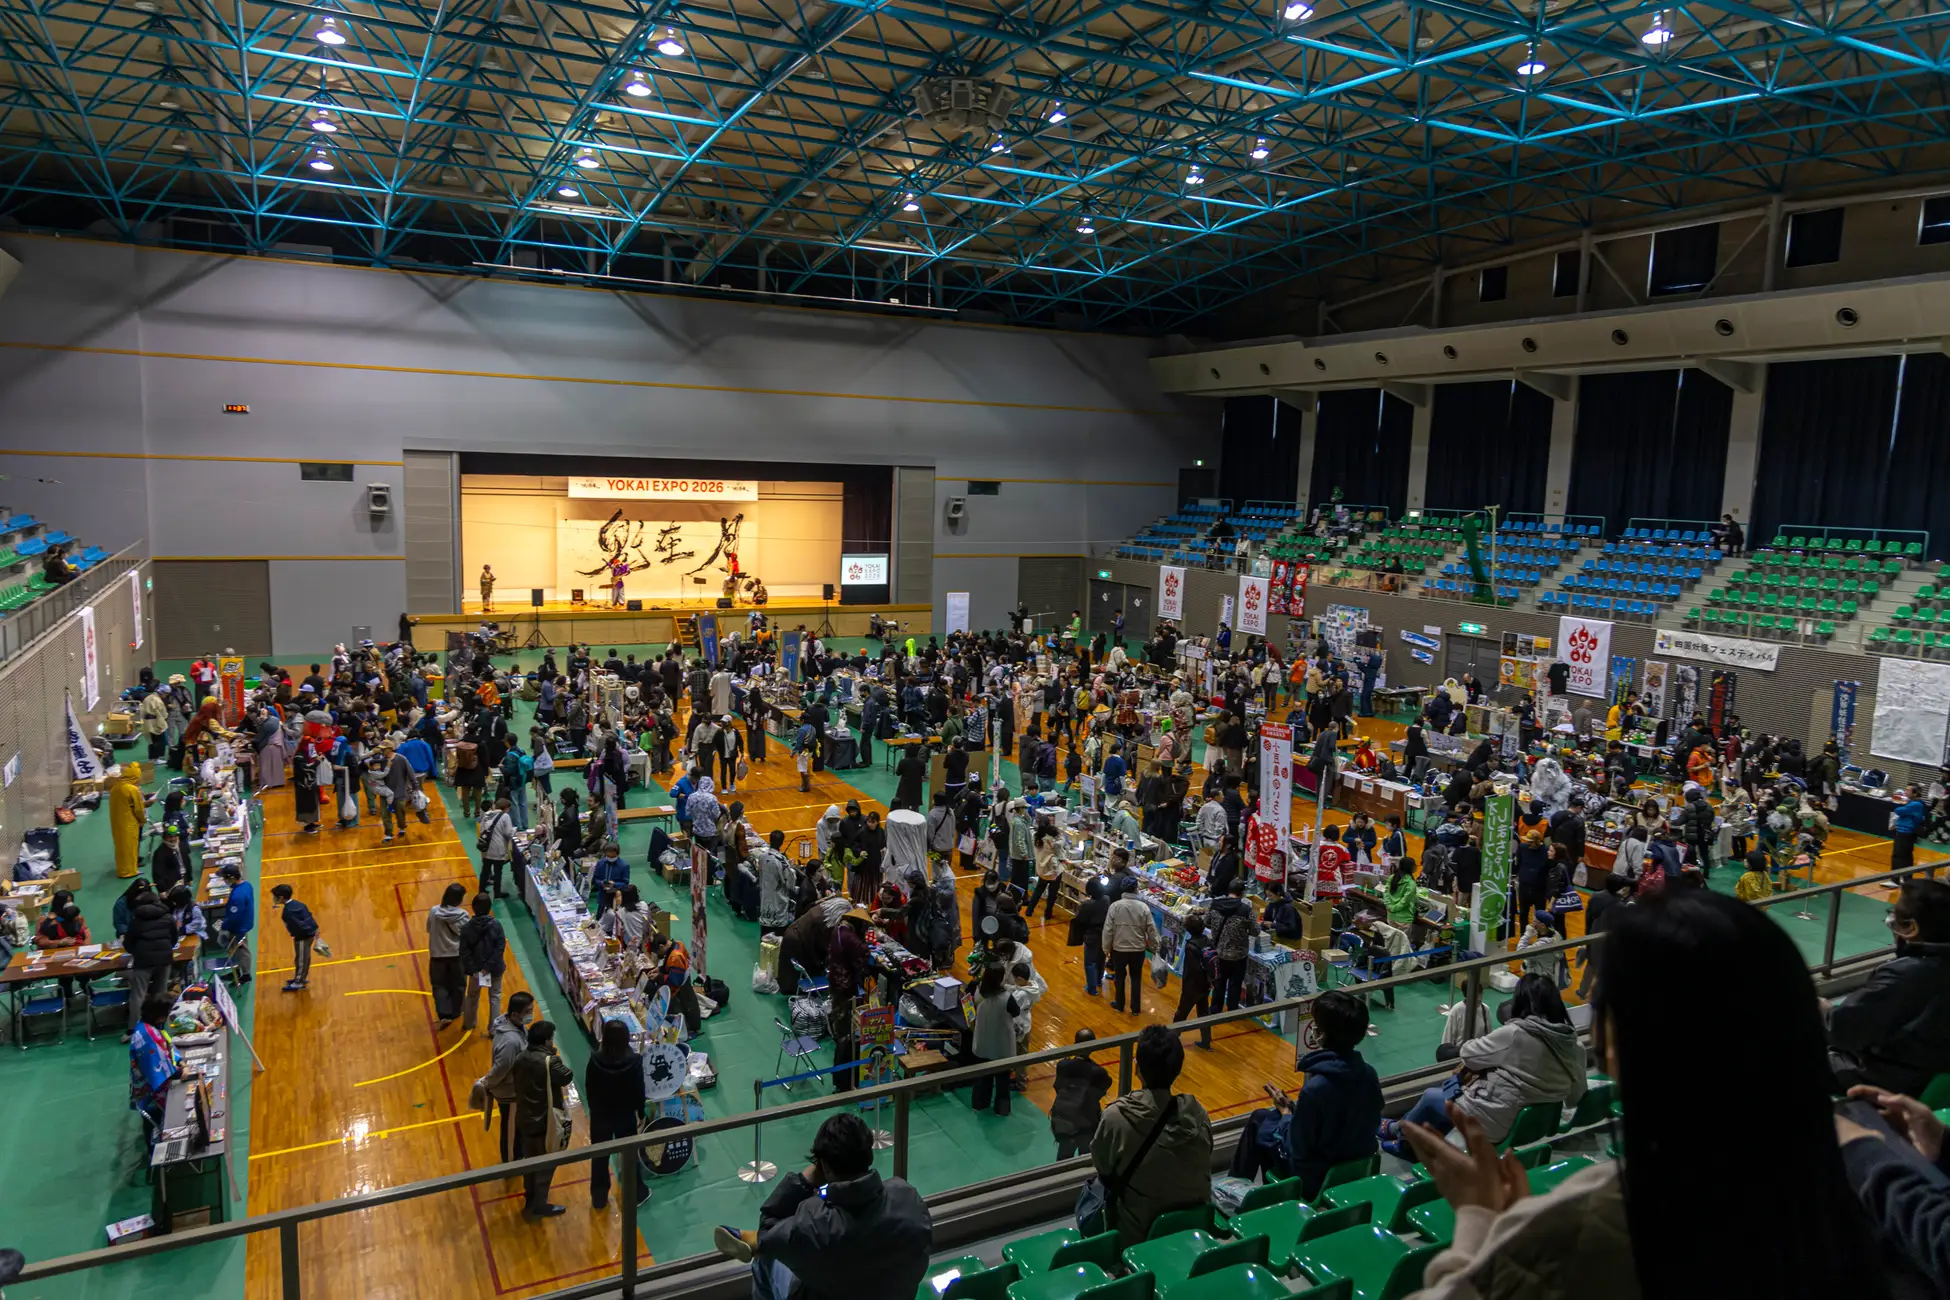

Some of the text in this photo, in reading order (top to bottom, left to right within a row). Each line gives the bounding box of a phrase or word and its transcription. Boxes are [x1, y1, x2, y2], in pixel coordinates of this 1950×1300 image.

[607, 479, 649, 491] YOKAI
[653, 480, 689, 492] EXPO
[692, 481, 724, 493] 2026
[1243, 618, 1259, 627] EXPO
[1567, 677, 1593, 686] XPO
